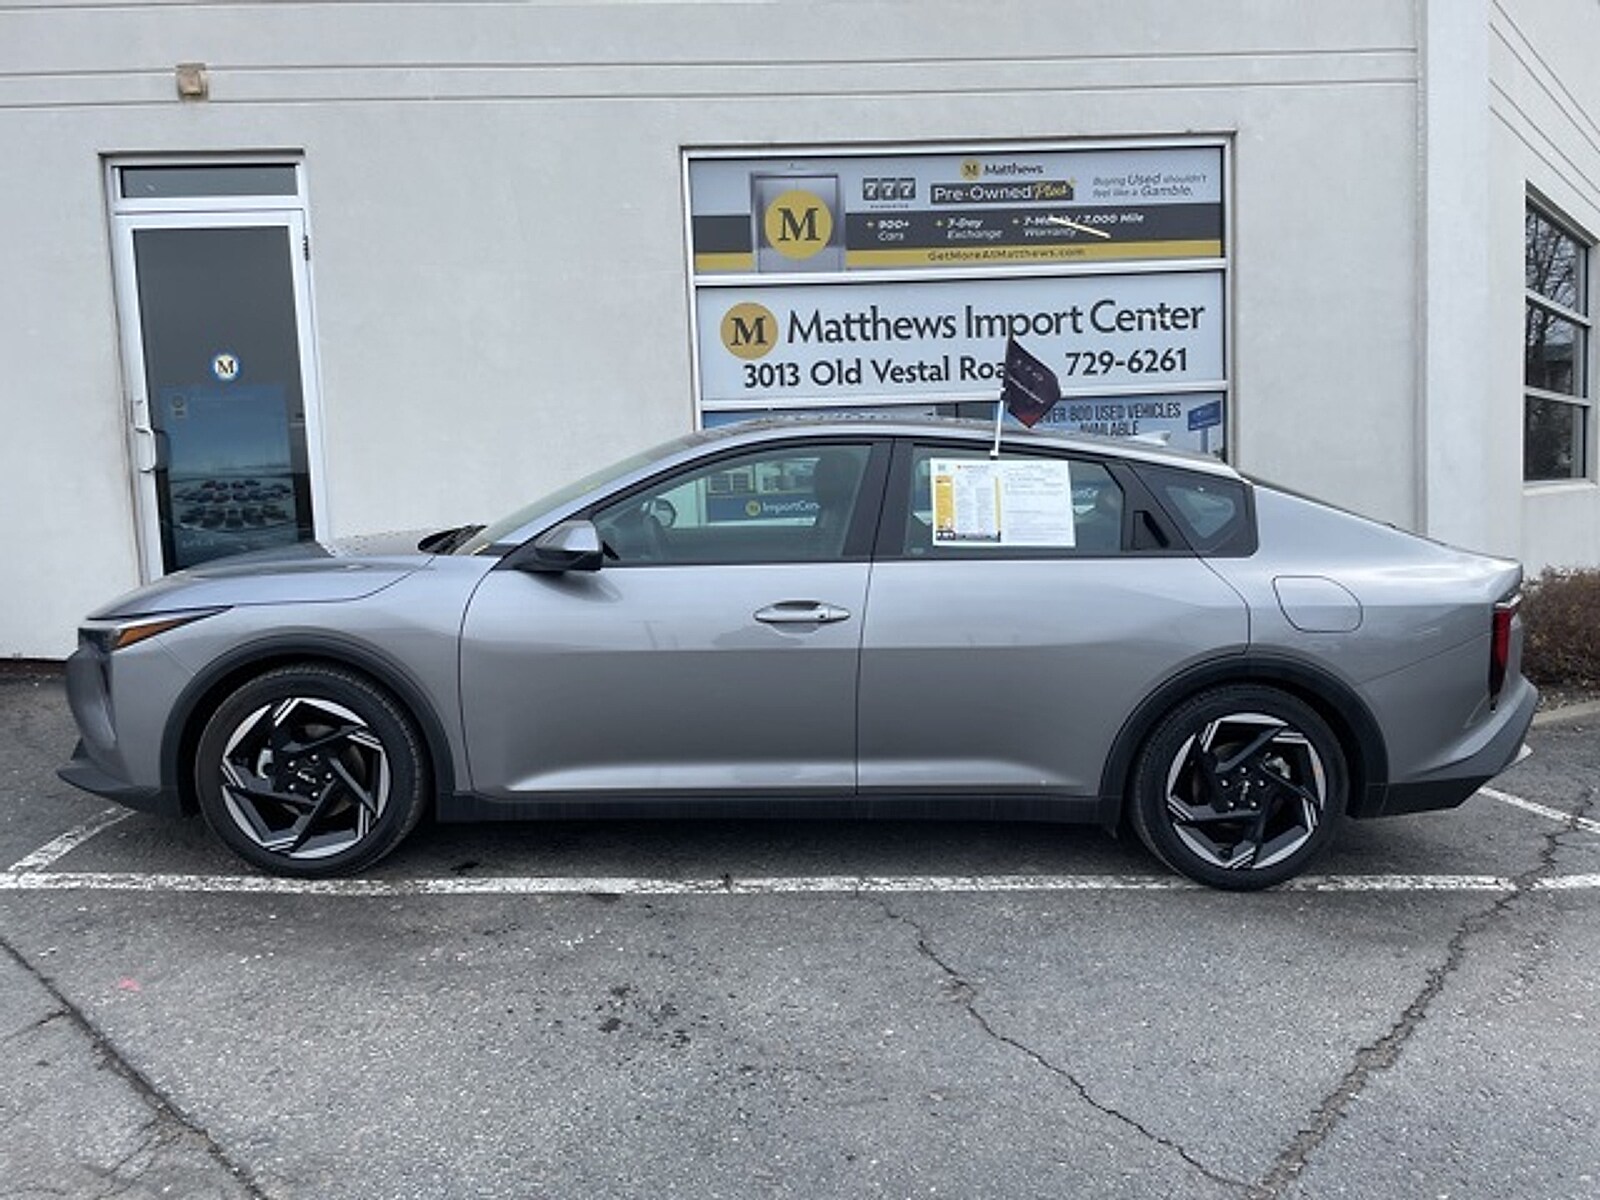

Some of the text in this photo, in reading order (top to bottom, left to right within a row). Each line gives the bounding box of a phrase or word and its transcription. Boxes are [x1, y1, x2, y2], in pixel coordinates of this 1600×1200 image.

[984, 163, 1044, 176] Matthews
[1127, 172, 1161, 186] Used
[778, 207, 820, 241] M
[947, 229, 1003, 241] Exchange
[731, 315, 768, 347] M
[787, 299, 1206, 344] Matthews Import Center
[217, 359, 235, 374] M
[744, 361, 800, 389] 3013
[809, 358, 863, 387] Old
[870, 355, 950, 384] Vestal
[960, 355, 1006, 381] Roa
[1065, 347, 1189, 377] 729-6261
